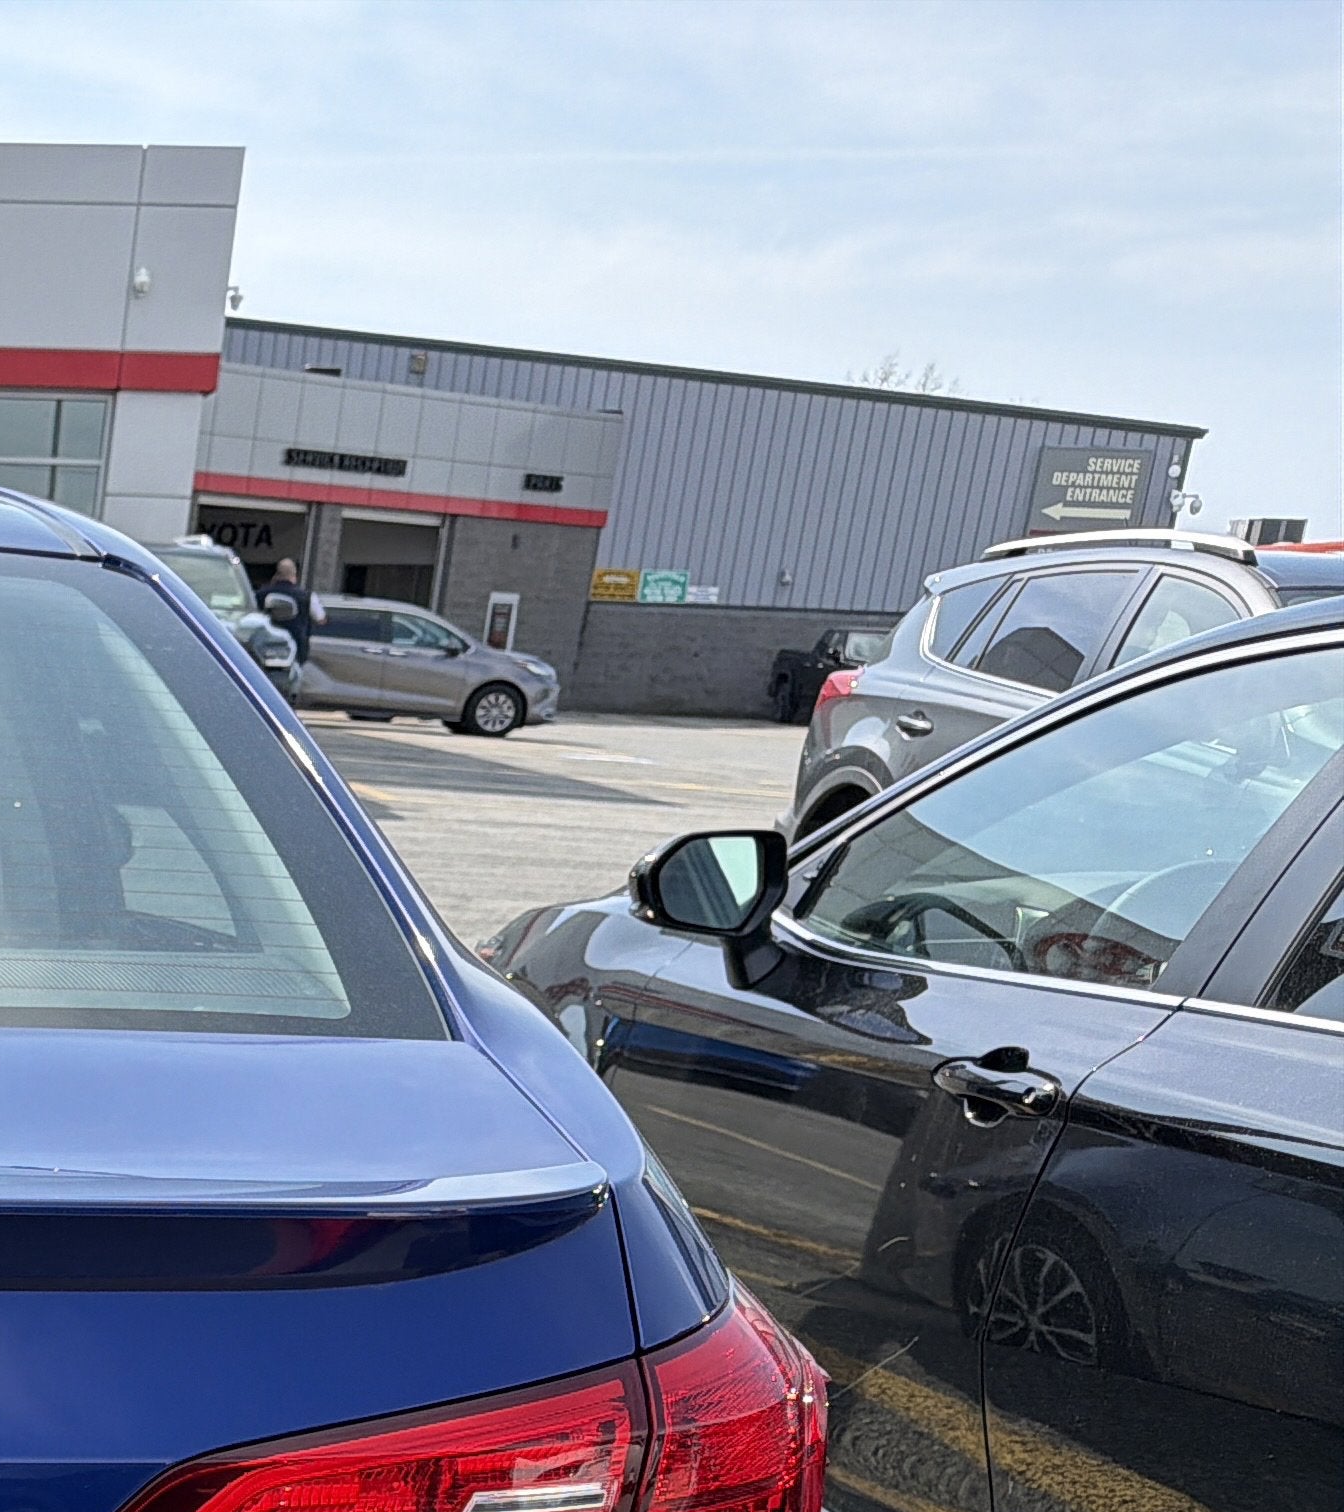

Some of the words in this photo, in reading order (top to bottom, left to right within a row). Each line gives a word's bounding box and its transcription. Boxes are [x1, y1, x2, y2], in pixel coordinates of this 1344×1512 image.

[1086, 457, 1141, 473] SERVICE
[1052, 471, 1138, 488] DEPARTMENT
[1066, 487, 1135, 503] ENTRANCE
